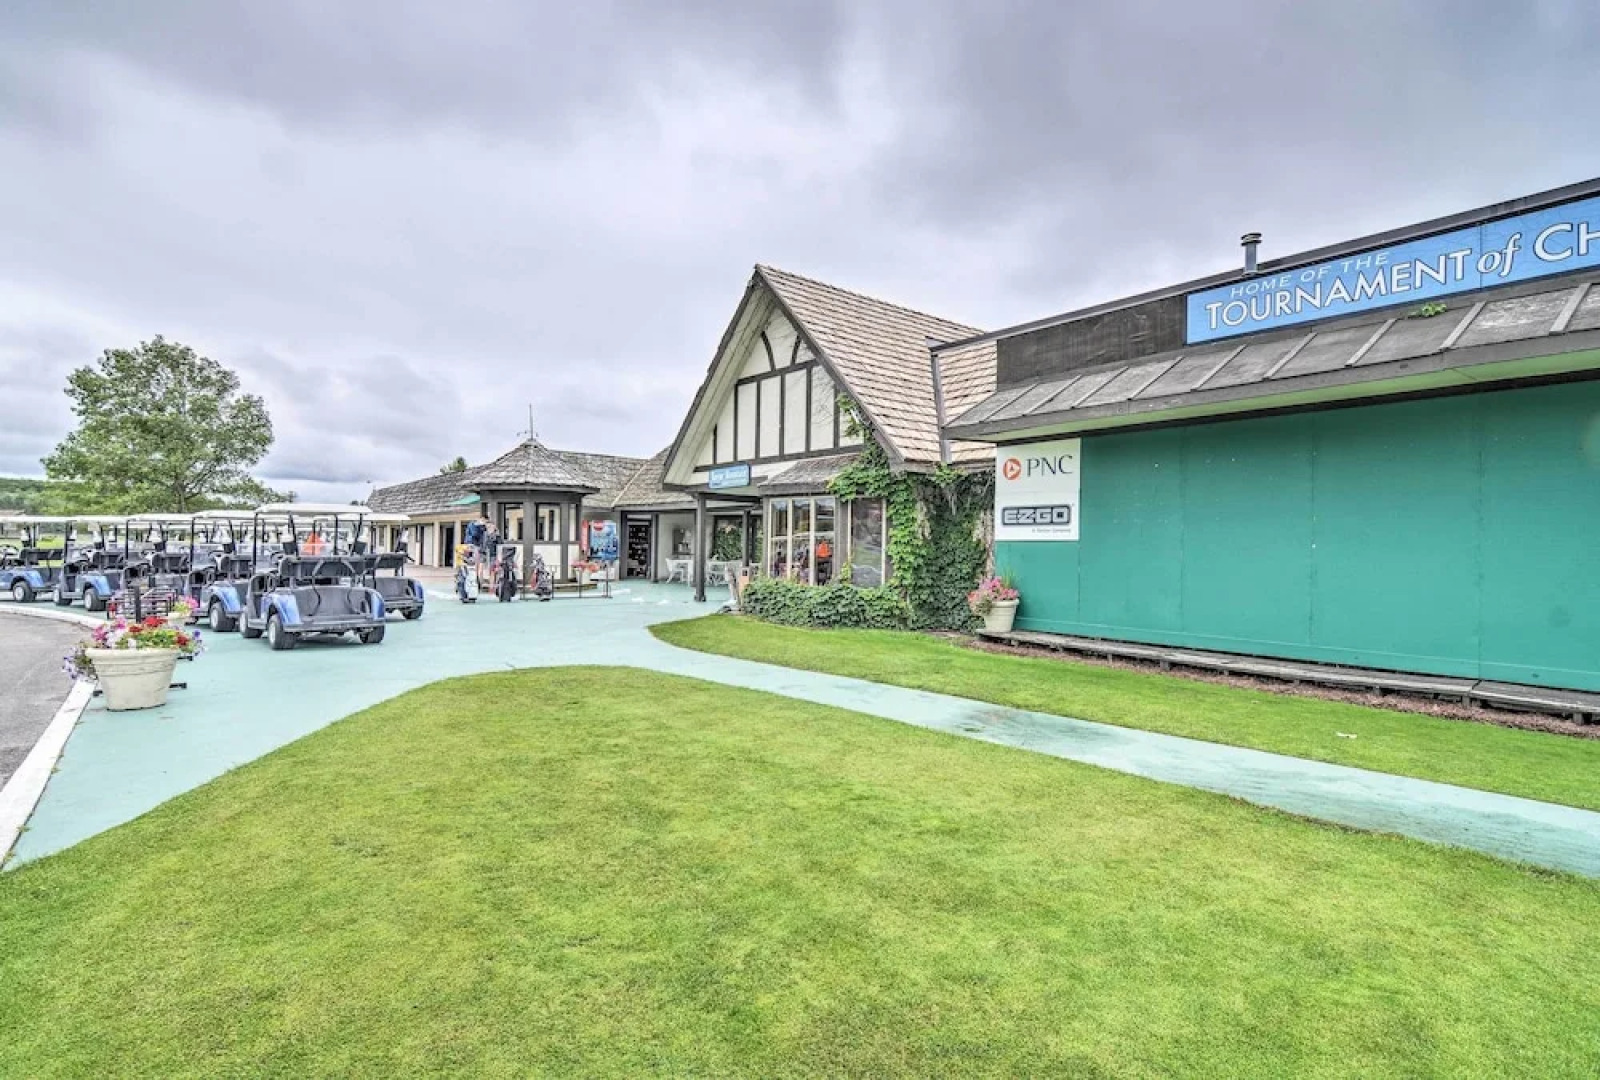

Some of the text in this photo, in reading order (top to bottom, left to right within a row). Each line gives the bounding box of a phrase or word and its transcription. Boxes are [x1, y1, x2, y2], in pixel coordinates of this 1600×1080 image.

[1205, 247, 1472, 330] TOURNAMENT
[1476, 231, 1522, 278] of
[1229, 252, 1391, 298] HOME OF THE
[1026, 453, 1073, 477] PNC
